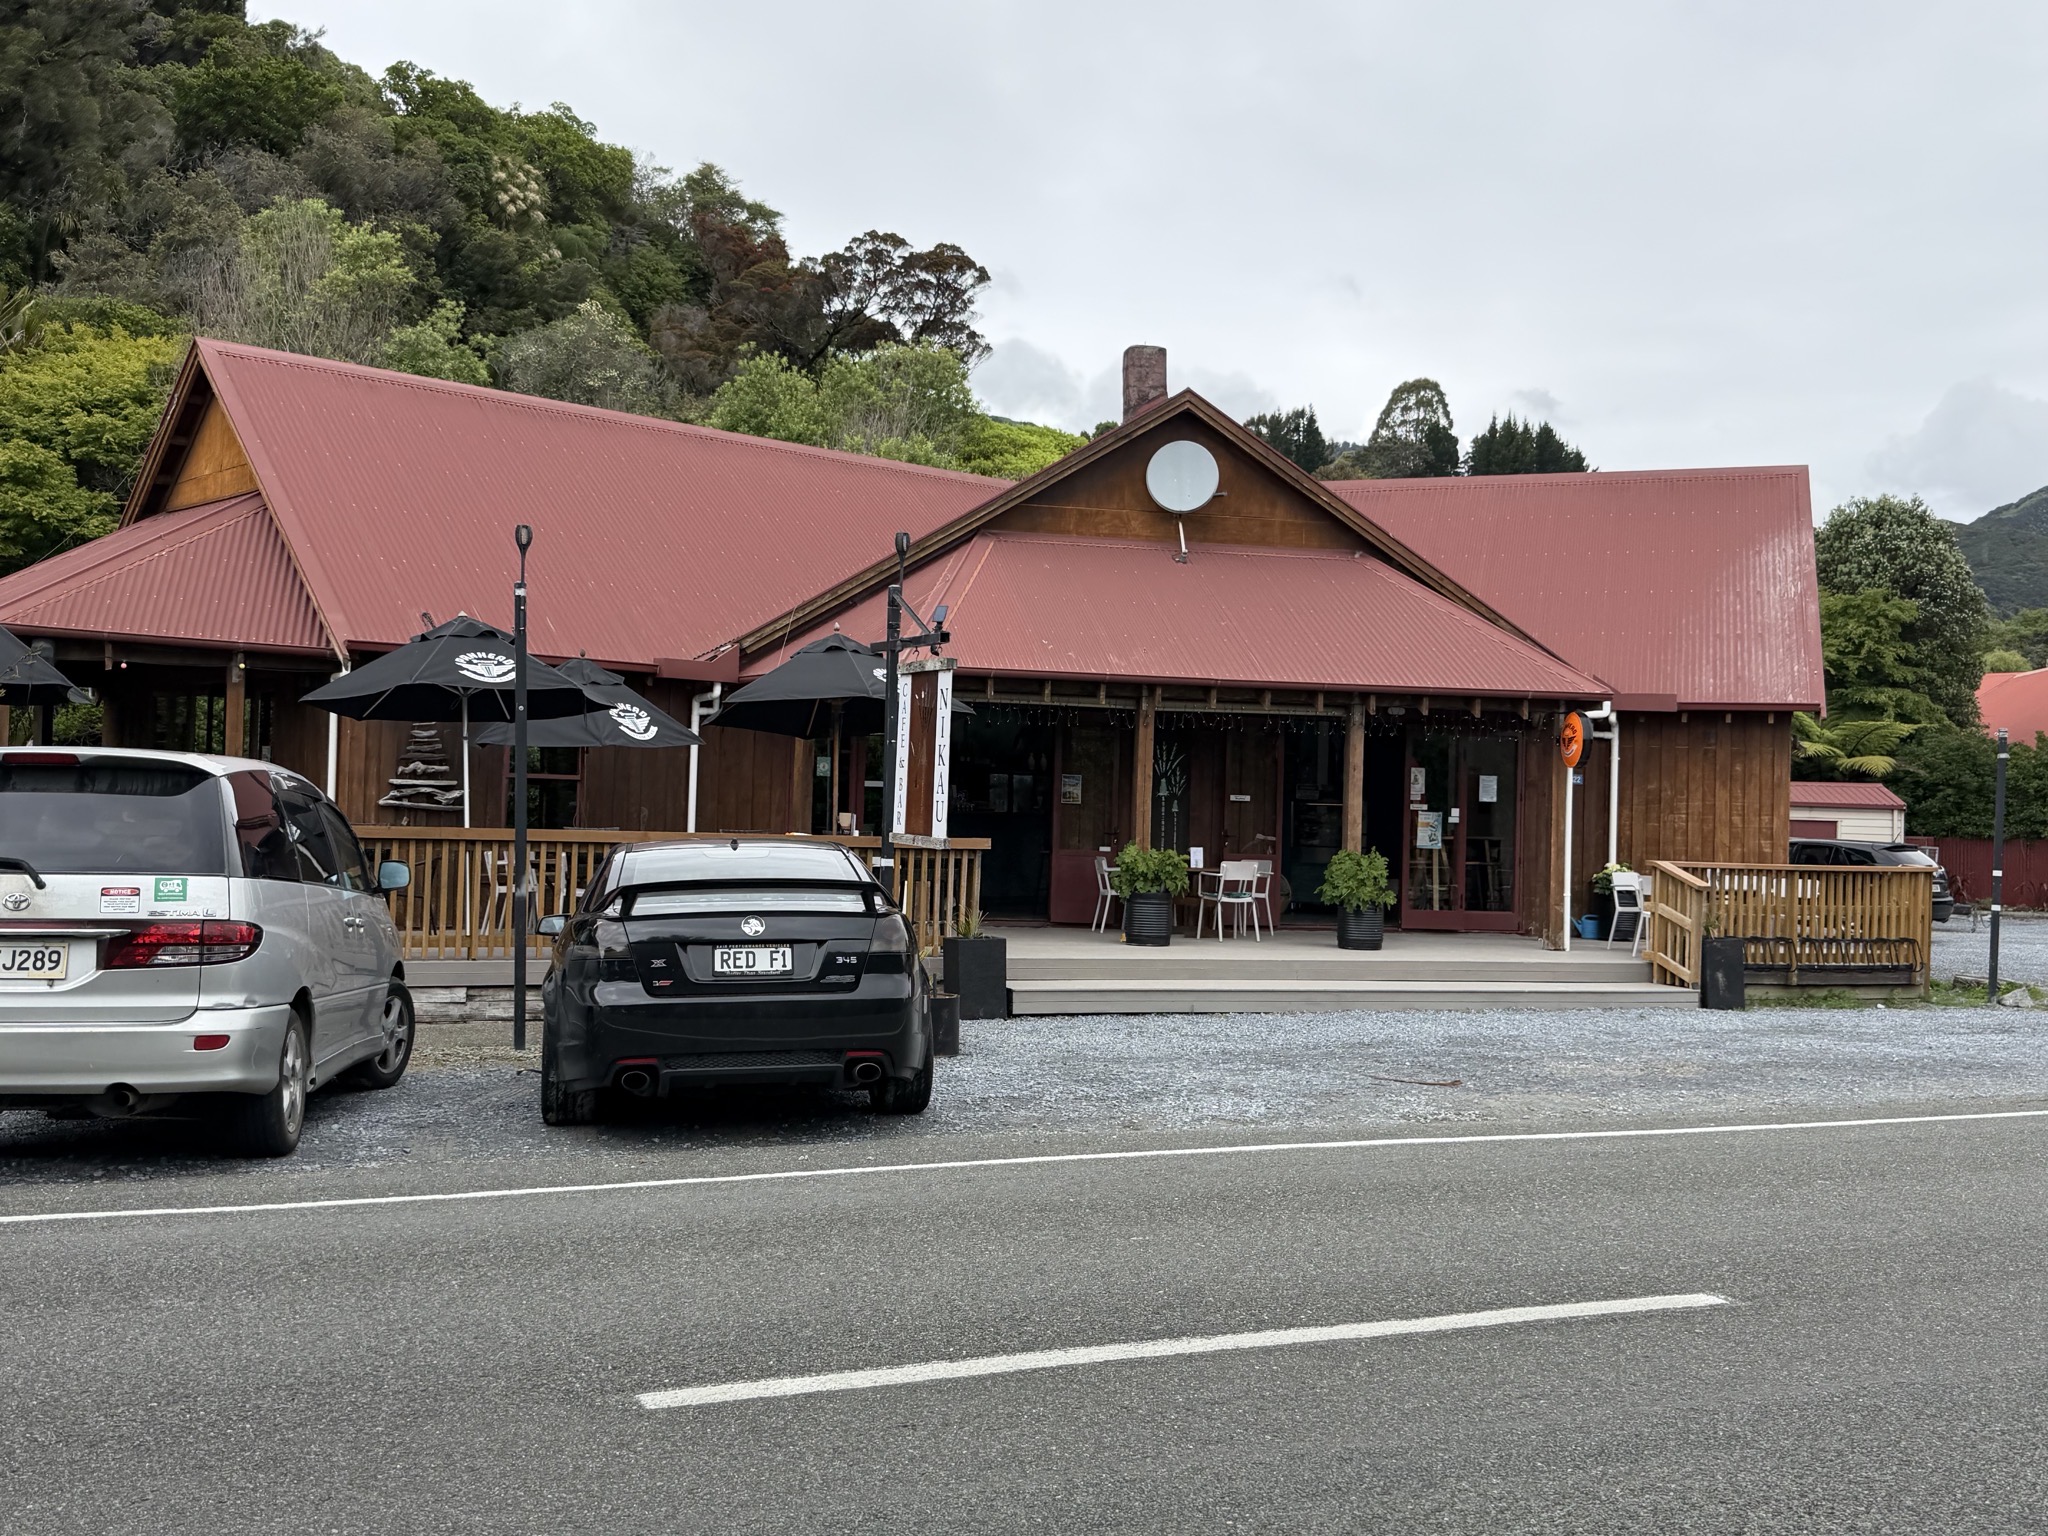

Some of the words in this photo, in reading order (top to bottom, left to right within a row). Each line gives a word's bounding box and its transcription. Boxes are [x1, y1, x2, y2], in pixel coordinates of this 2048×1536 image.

[454, 651, 515, 665] PANHEAD
[936, 688, 948, 823] NIKAU
[899, 757, 905, 769] &
[109, 888, 132, 896] NOTICE
[147, 910, 200, 918] ESTIMA
[202, 907, 217, 918] L
[0, 949, 62, 972] J289
[720, 950, 756, 970] RED
[769, 949, 788, 969] F1
[835, 956, 858, 964] 345
